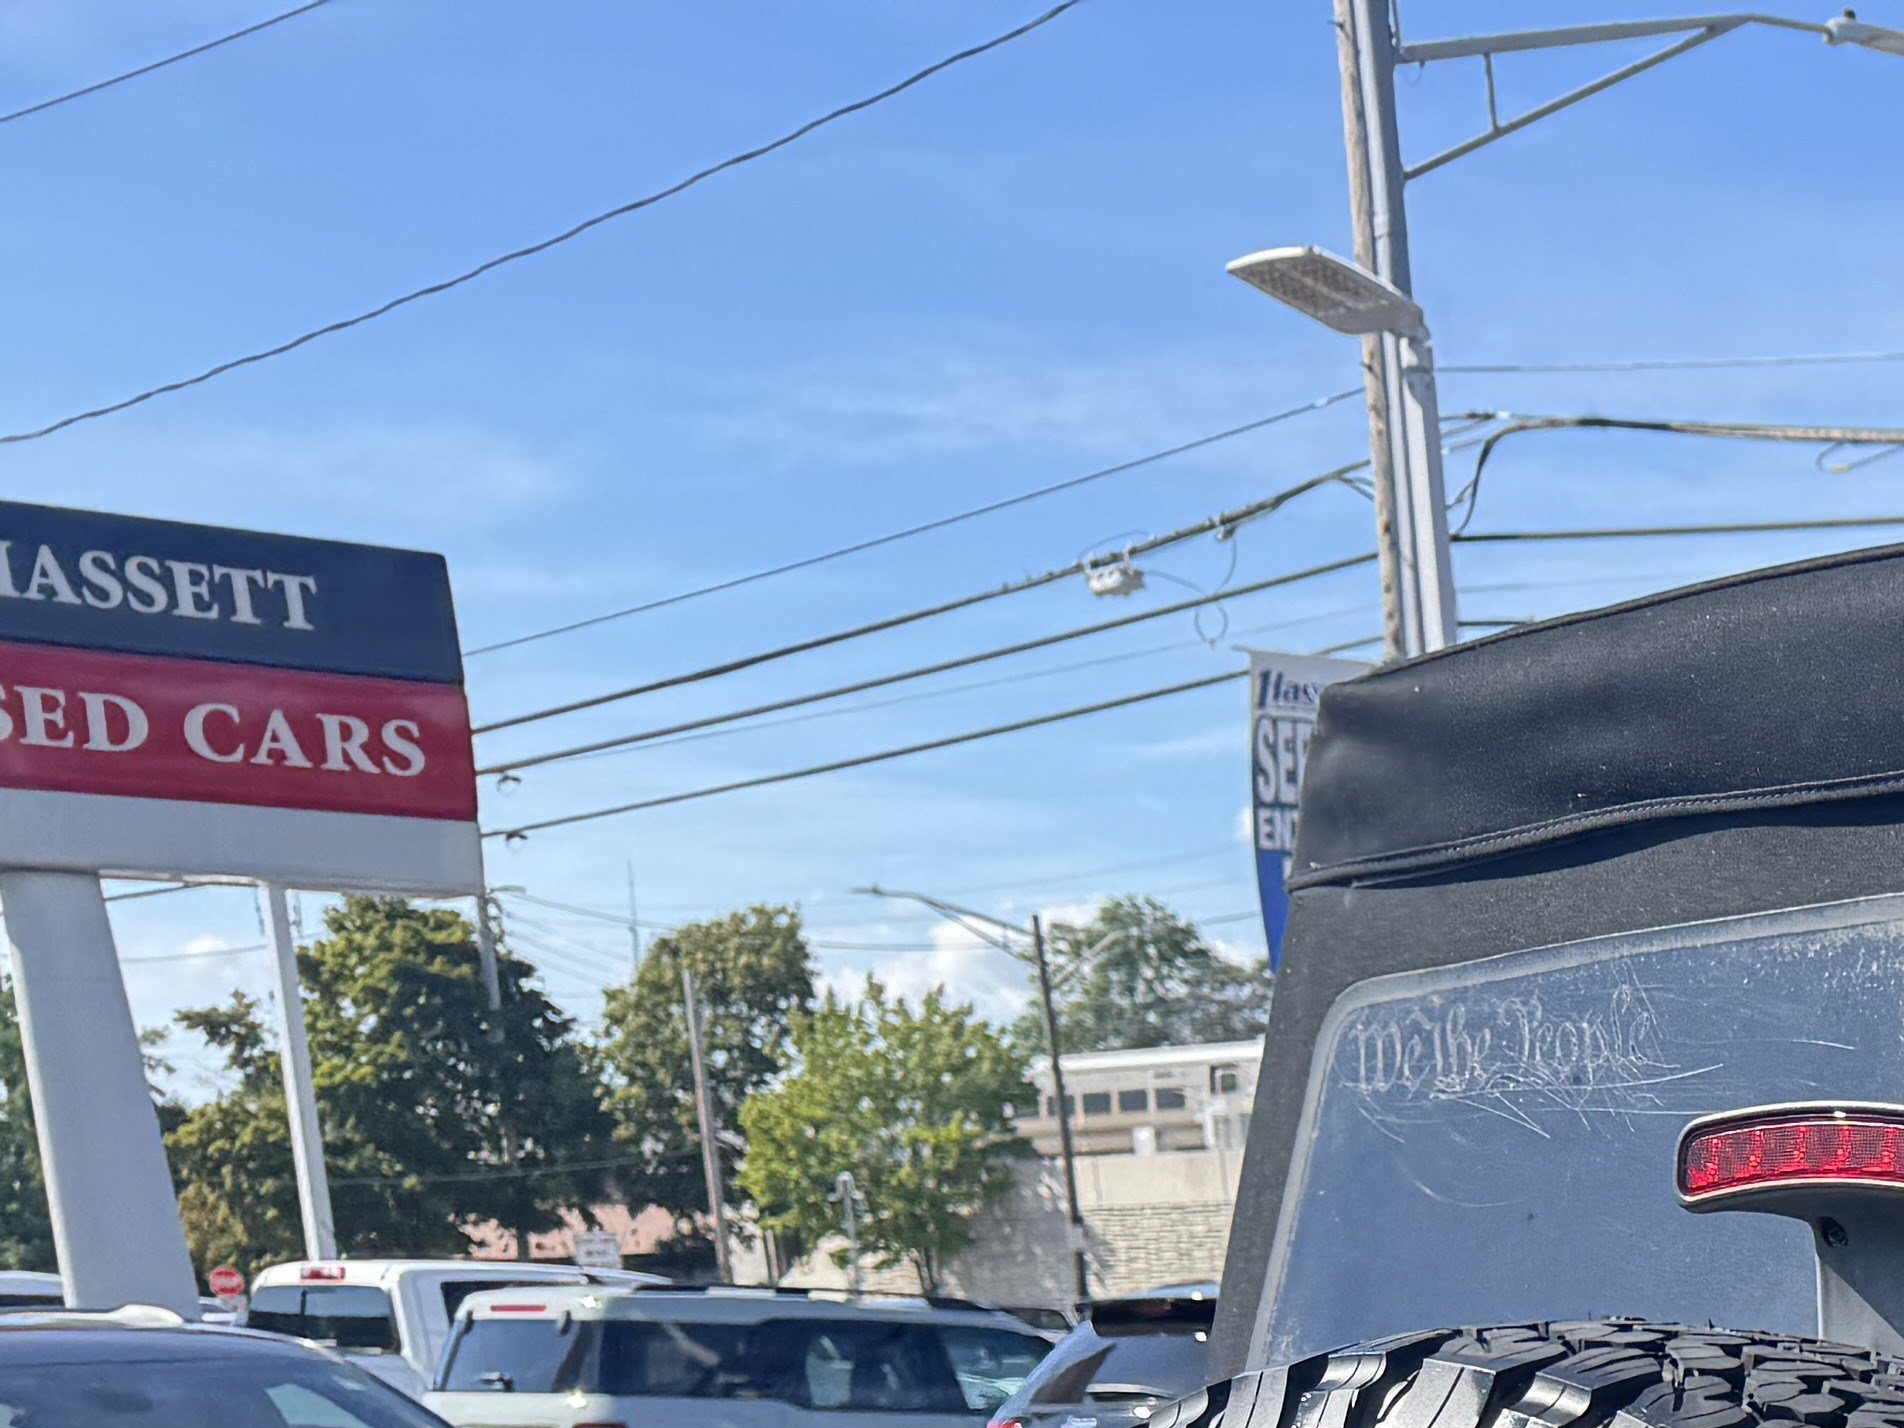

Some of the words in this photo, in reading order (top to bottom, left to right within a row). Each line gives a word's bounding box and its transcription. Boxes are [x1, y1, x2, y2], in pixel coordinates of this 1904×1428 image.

[0, 540, 317, 630] ASSETT
[0, 684, 148, 752] ED
[183, 703, 427, 777] CARS
